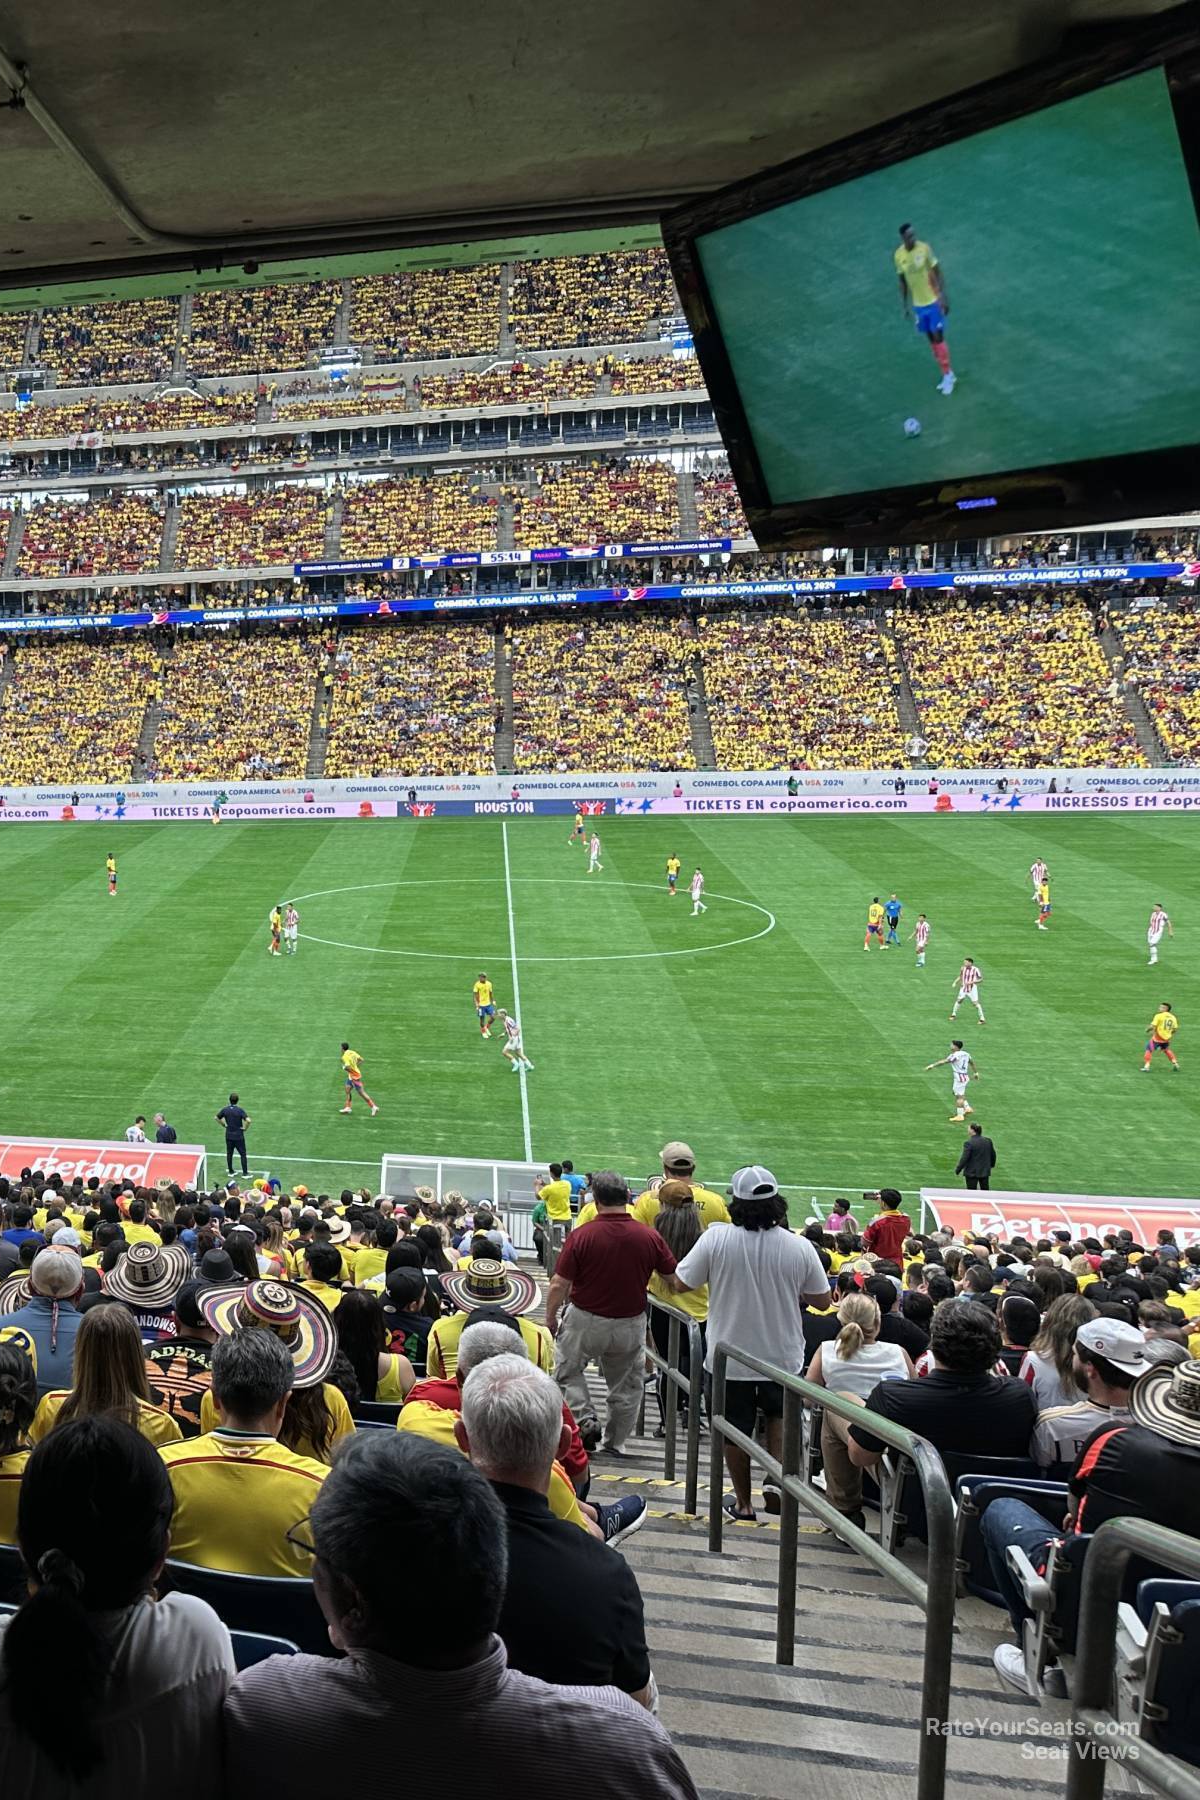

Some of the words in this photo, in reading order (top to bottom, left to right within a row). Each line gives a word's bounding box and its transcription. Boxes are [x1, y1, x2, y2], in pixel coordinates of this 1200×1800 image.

[490, 553, 521, 562] 55:14
[953, 573, 1007, 583] CONMEBOL
[1008, 572, 1034, 581] COPA
[1035, 570, 1080, 580] AMERICA
[1082, 570, 1102, 578] USA
[1103, 569, 1127, 577] 2024
[681, 586, 729, 596] CONMEBOL
[730, 585, 752, 594] COPA
[753, 584, 793, 593] AMERICA
[795, 583, 812, 591] USA
[814, 582, 835, 590] 2024
[434, 598, 478, 608] CONMEBOL
[479, 597, 501, 606] COPA
[502, 595, 538, 605] AMERICA
[540, 594, 556, 603] USA
[557, 593, 577, 602] 2024
[269, 608, 302, 616] AMERICA
[475, 802, 534, 813] HOUSTON
[684, 800, 742, 810] TICKETS
[746, 800, 764, 809] EN
[770, 798, 908, 811] copaamerica.com
[1046, 796, 1128, 807] INGRESSOS
[1135, 796, 1156, 806] EM
[152, 807, 199, 816] TICKETS
[221, 805, 335, 818] copaamerica.com
[32, 1157, 145, 1179] Betano
[607, 1514, 619, 1538] N
